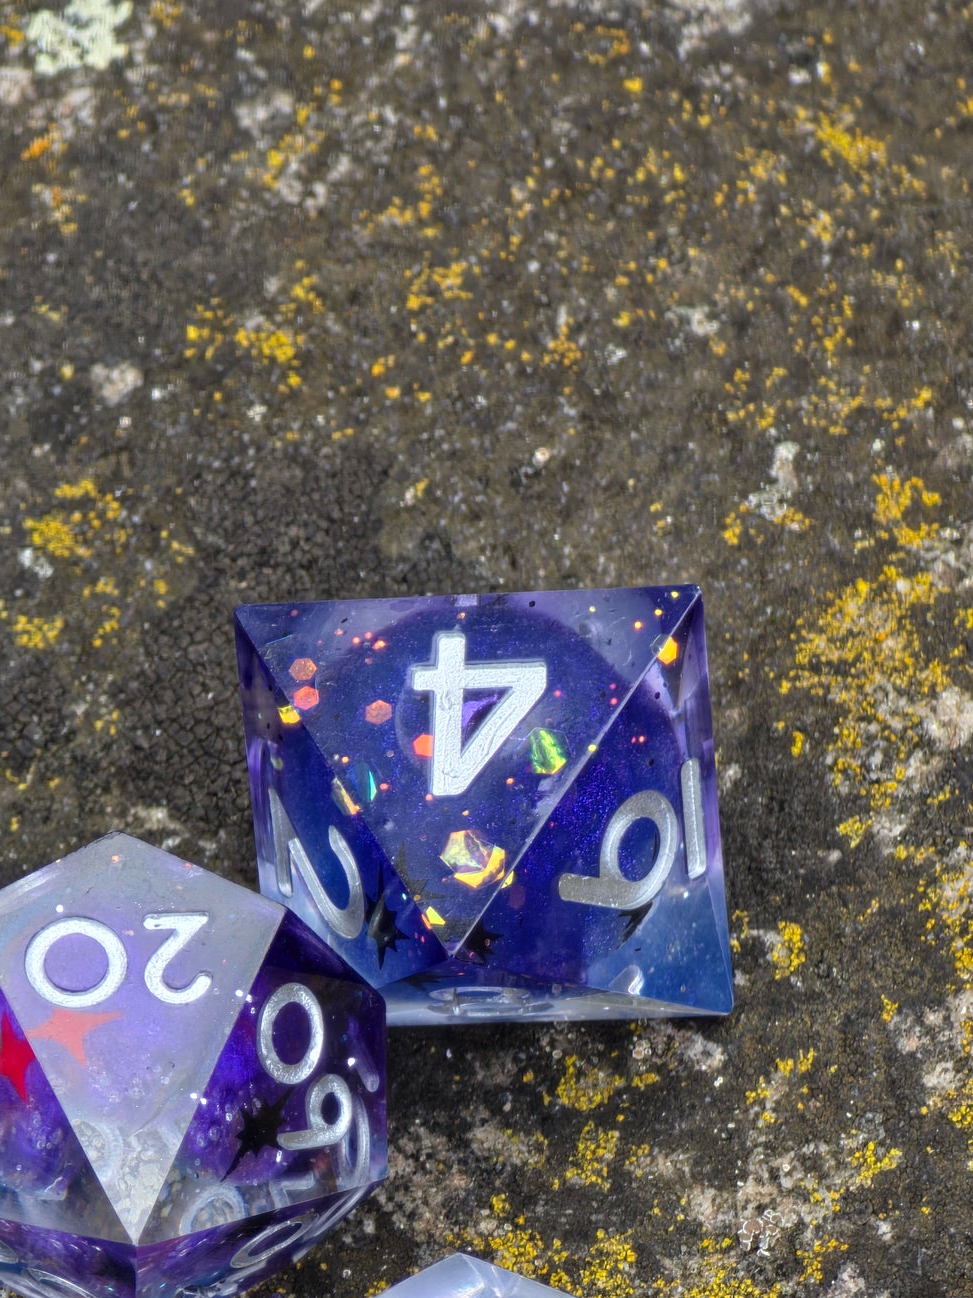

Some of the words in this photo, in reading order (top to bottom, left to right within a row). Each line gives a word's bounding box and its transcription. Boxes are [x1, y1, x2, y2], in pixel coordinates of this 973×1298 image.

[410, 630, 547, 796] 4
[268, 787, 365, 939] 2
[24, 911, 214, 1009] 20
